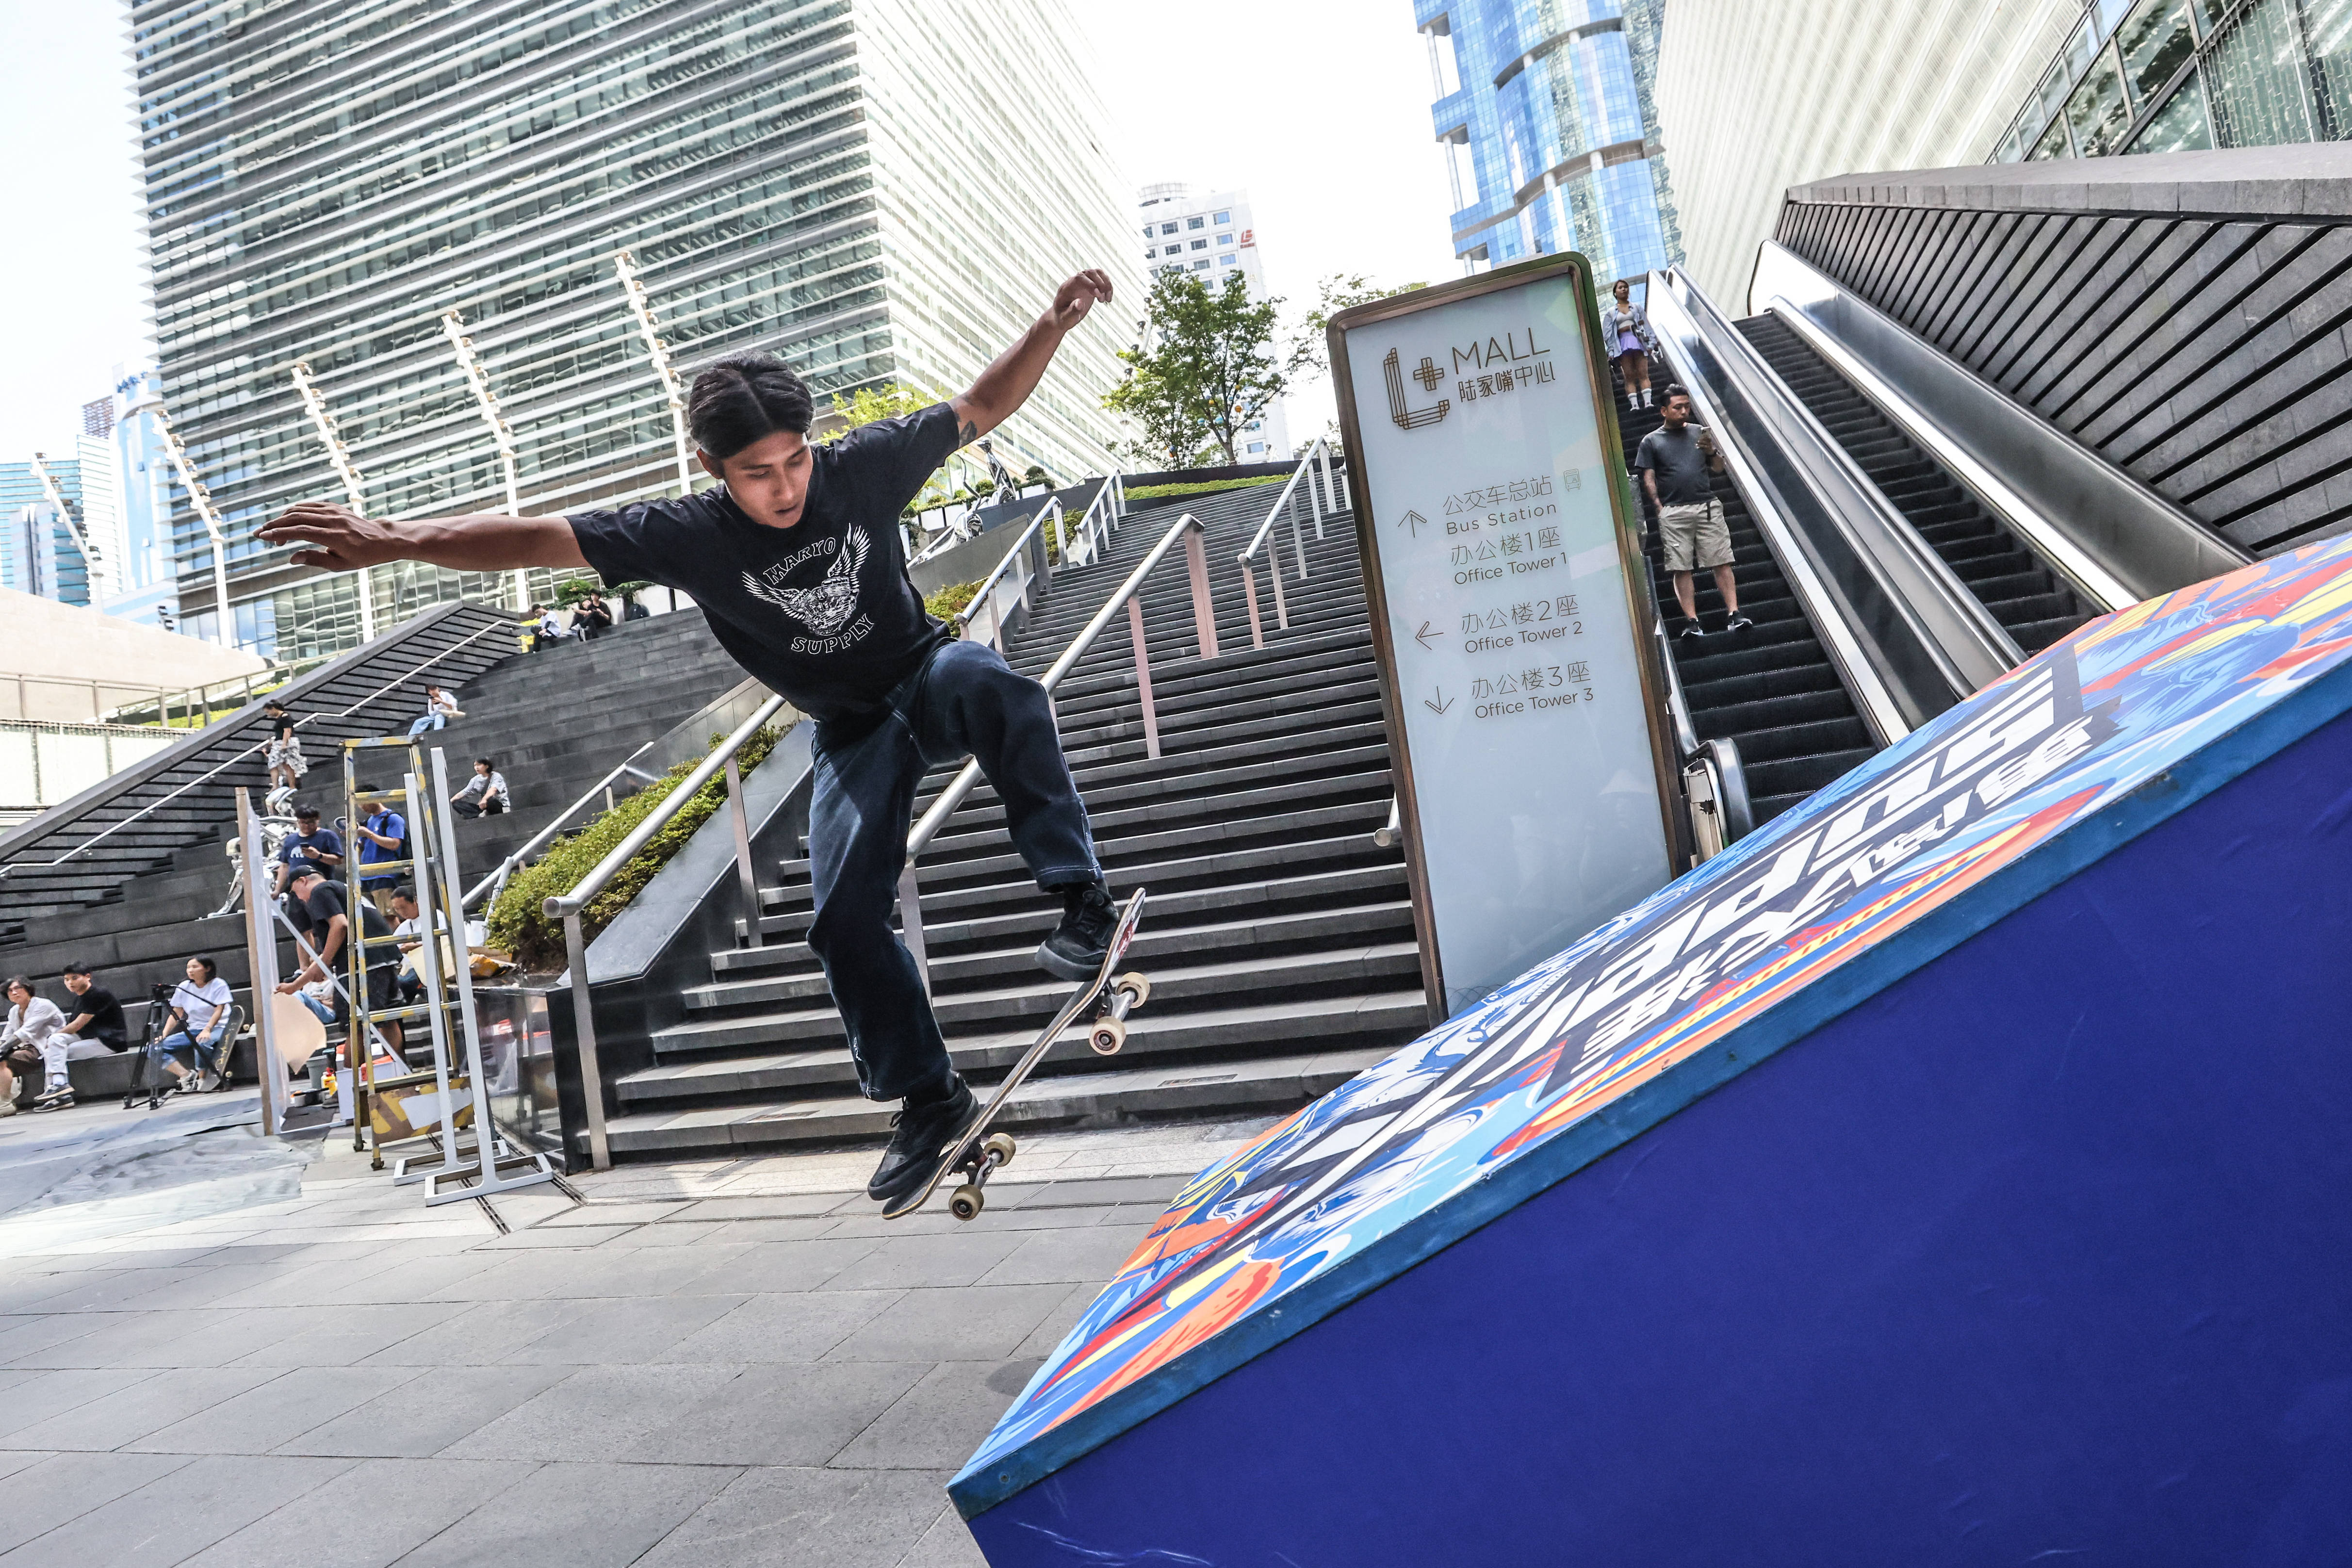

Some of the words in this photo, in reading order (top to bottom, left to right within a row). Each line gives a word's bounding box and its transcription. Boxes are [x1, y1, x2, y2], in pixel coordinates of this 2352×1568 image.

[1452, 327, 1551, 375] MALL
[1458, 361, 1556, 403] 陆家嘴中心
[1442, 475, 1552, 515] 公交车总站
[1446, 520, 1480, 535] Bus
[1487, 504, 1556, 526] Station
[763, 537, 836, 585] MARYO
[1451, 526, 1561, 566] 办公楼1座
[1454, 568, 1503, 585] Office
[1507, 556, 1556, 574] Tower
[1560, 552, 1567, 564] 1
[791, 613, 874, 654] SUPPLY
[1462, 594, 1580, 635] 办公楼2座
[1465, 637, 1514, 653] Office
[1518, 626, 1567, 643] Tower
[1572, 621, 1583, 635] 2
[1472, 661, 1591, 699] 办公楼3座
[1475, 702, 1524, 718] Office
[1528, 693, 1578, 709] Tower
[1584, 687, 1593, 701] 3
[1571, 715, 2094, 1074] 勇闯天涯
